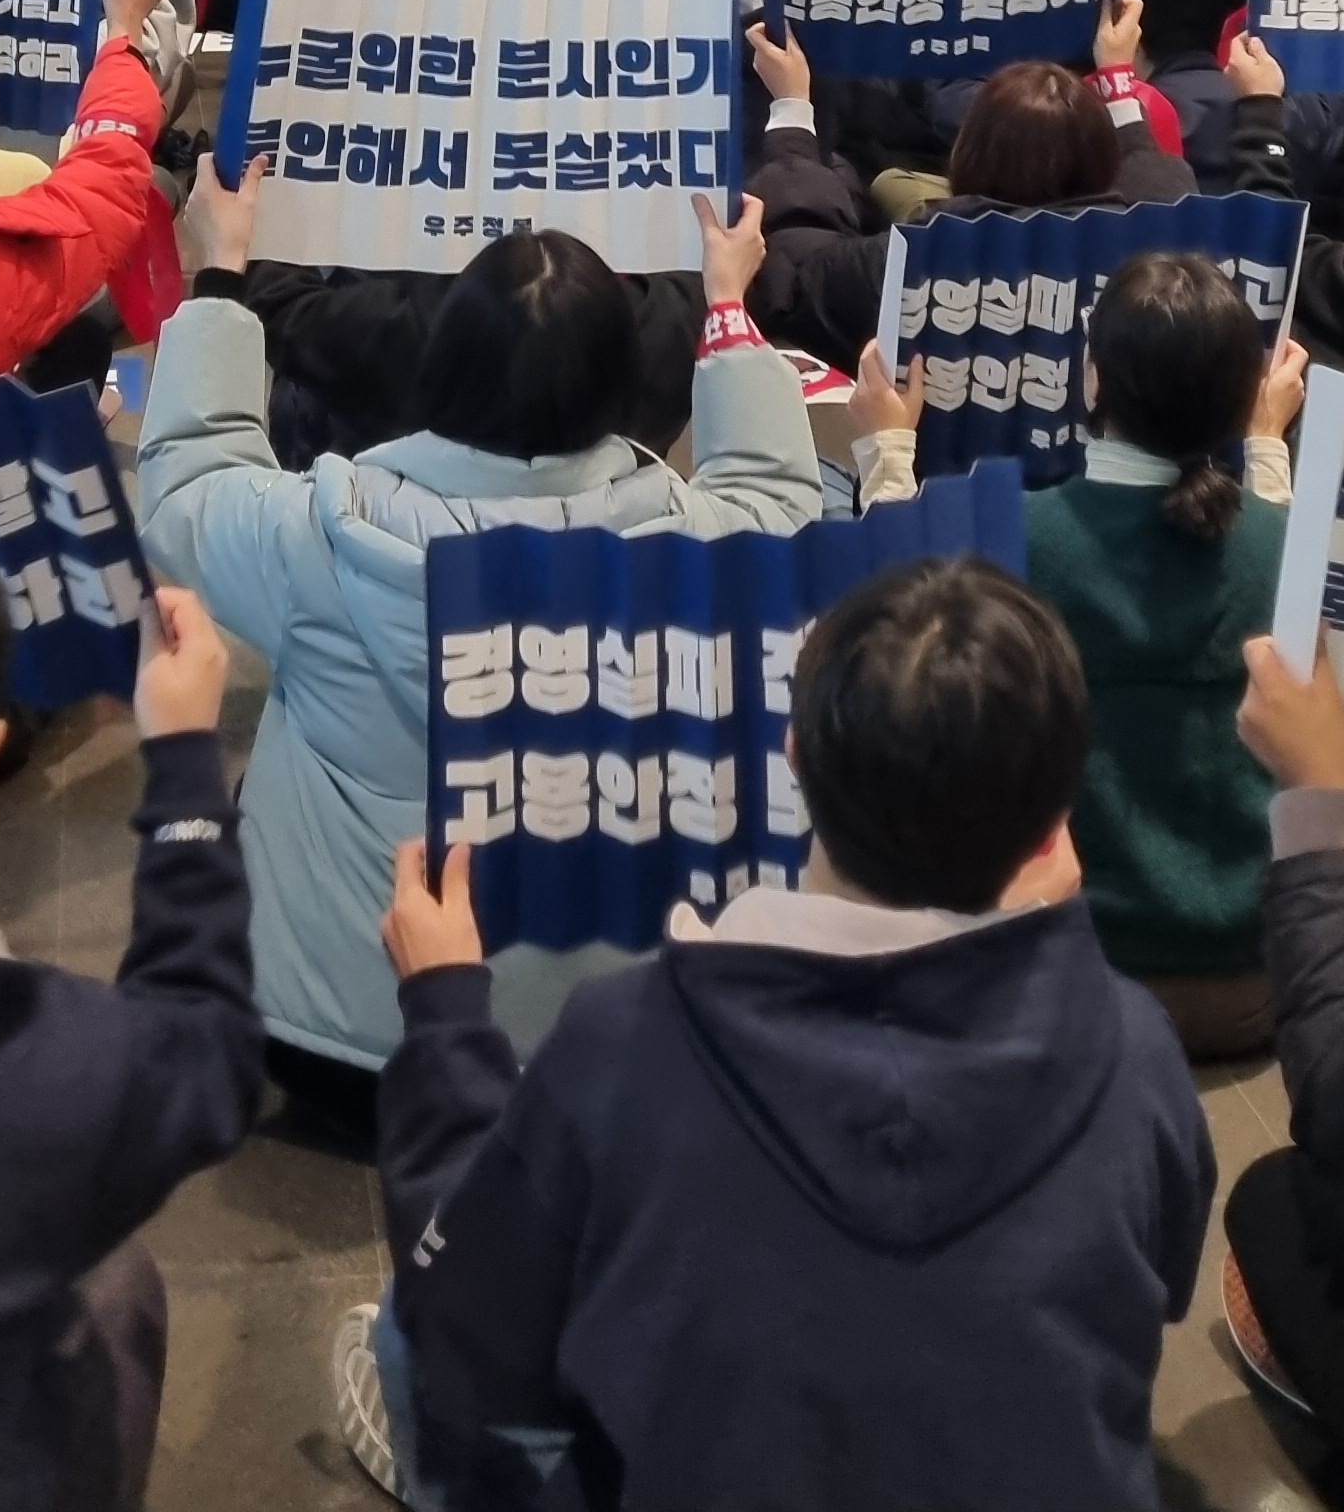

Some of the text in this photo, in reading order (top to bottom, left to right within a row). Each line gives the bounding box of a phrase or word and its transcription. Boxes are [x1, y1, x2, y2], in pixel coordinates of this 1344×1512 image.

[257, 27, 731, 98] 누굴위한 분사인가
[493, 128, 731, 189] 못살겠다
[922, 353, 1069, 412] 용안정
[4, 556, 142, 631] 하라
[442, 624, 733, 721] 경영실패
[445, 750, 737, 845] 고용안정
